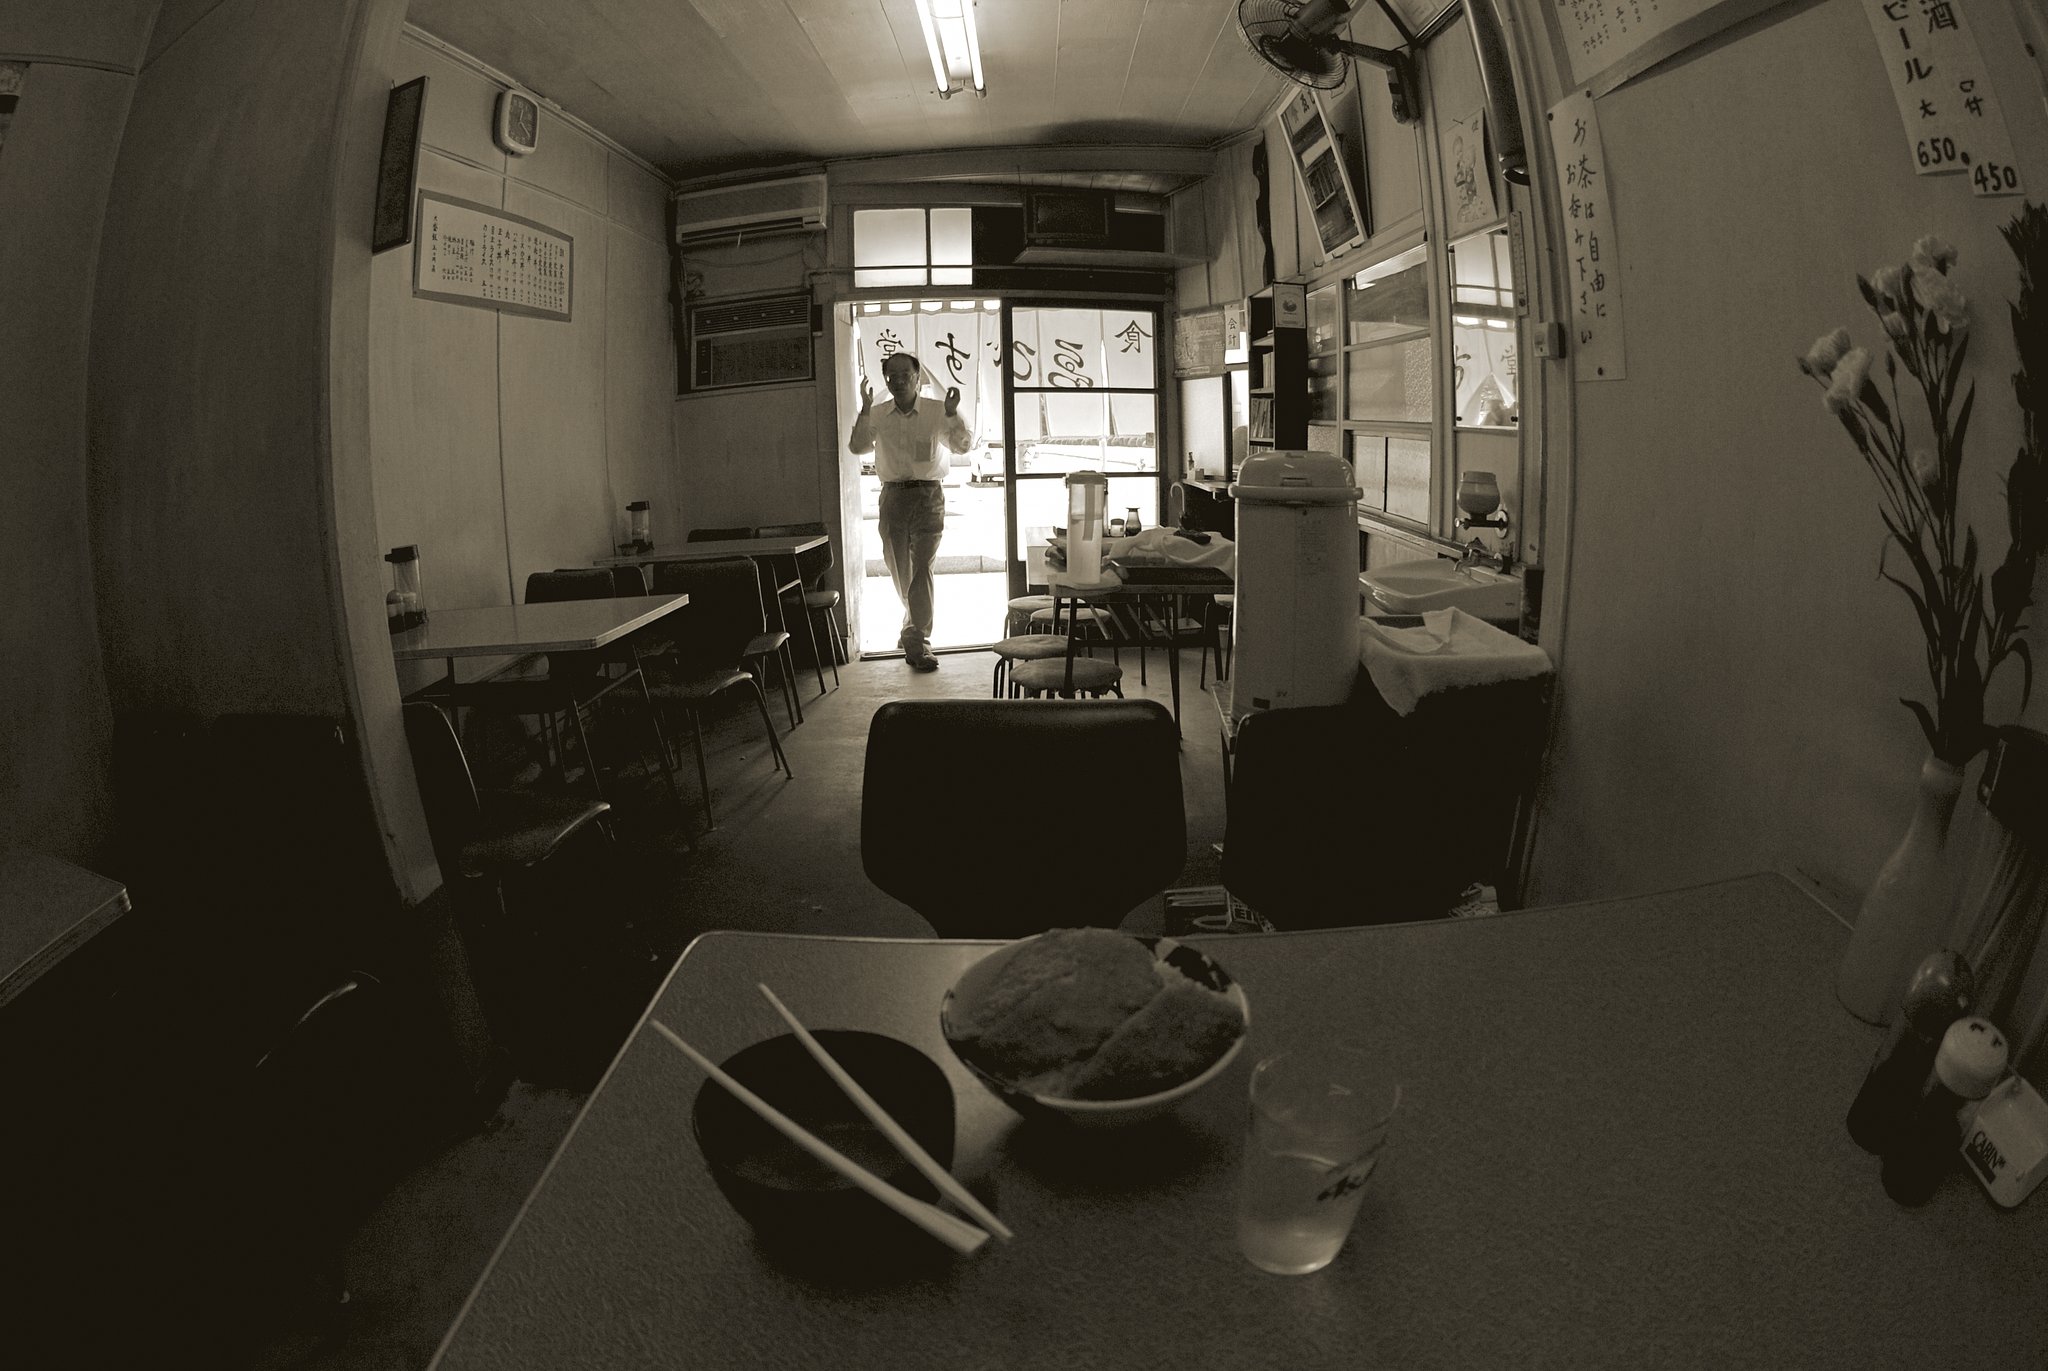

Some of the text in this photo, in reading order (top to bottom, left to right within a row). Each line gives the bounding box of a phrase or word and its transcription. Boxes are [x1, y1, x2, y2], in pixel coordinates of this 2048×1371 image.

[1883, 0, 1933, 84] ビール
[1917, 137, 1956, 166] 650
[1974, 162, 2017, 192] 450
[1572, 118, 1606, 319] お茶は自由に
[1227, 318, 1238, 347] 会計
